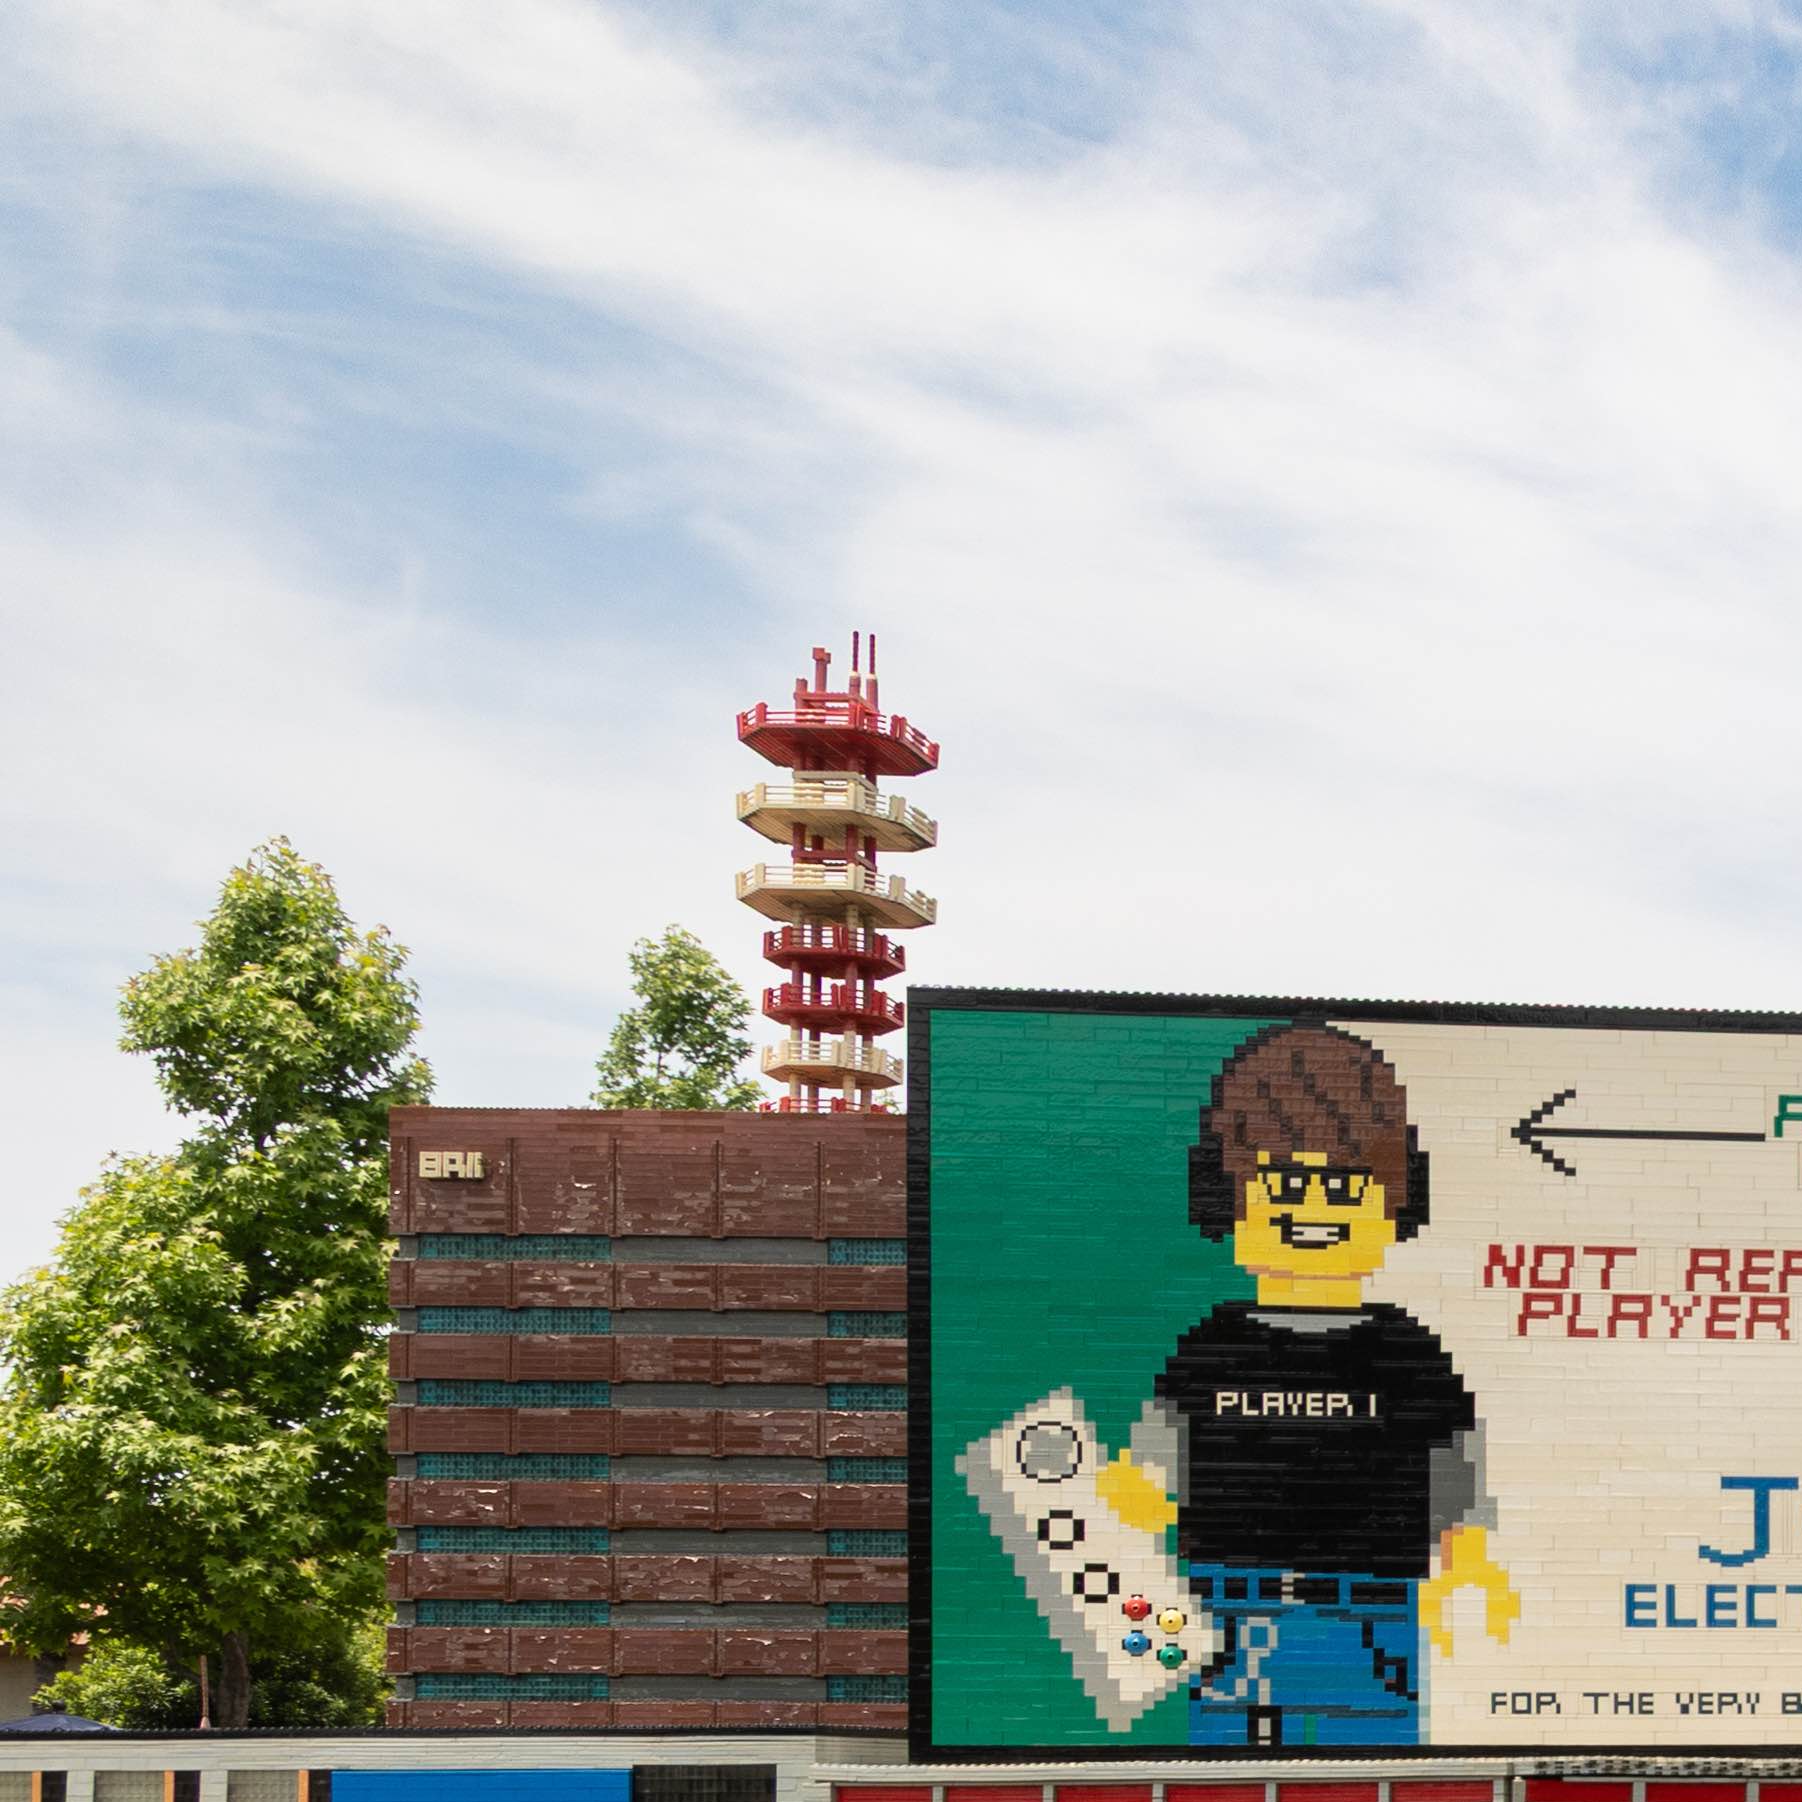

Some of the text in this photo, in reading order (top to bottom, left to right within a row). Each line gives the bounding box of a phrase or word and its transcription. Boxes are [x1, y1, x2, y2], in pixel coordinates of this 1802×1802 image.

[1483, 1244, 1636, 1289] NOT
[1518, 1292, 1790, 1340] PLAYER
[1216, 1391, 1353, 1417] PLAYER
[1491, 1692, 1561, 1714] FOR
[1583, 1692, 1654, 1715] THE
[1676, 1692, 1760, 1715] VERY
